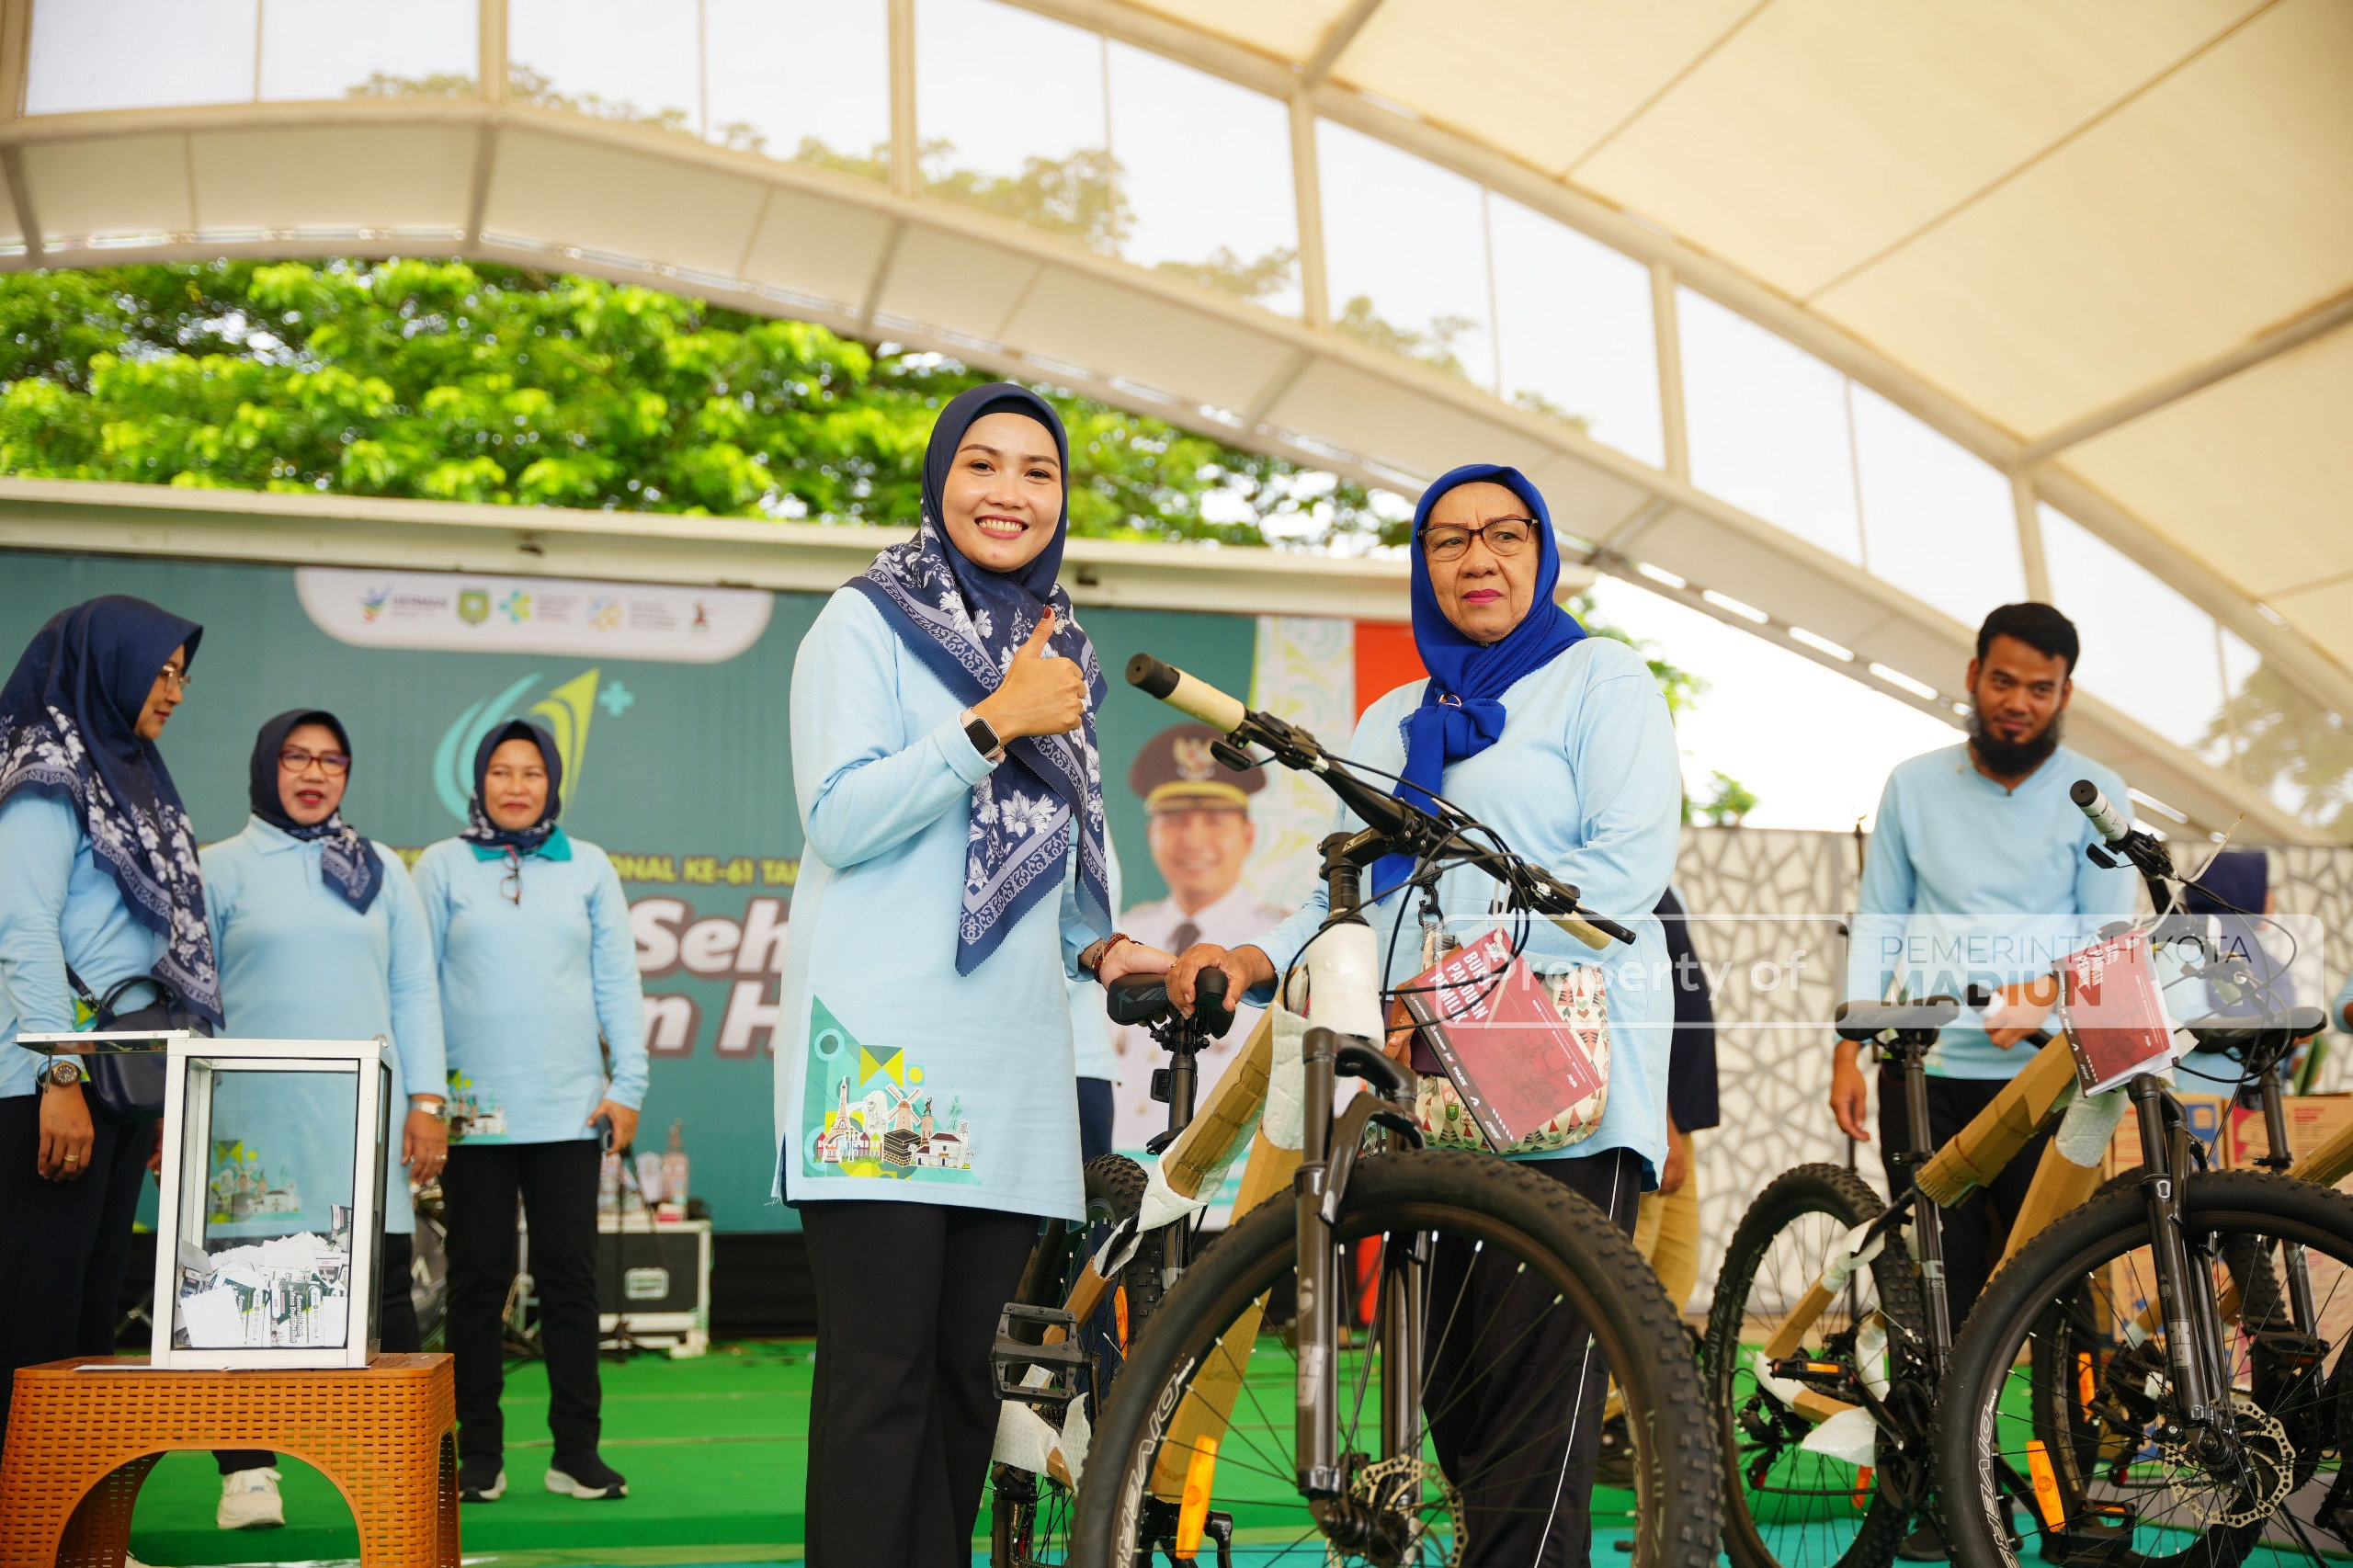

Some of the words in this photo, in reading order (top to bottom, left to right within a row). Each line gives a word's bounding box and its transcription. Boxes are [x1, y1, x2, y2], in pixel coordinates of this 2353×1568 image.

[684, 857, 755, 885] KE-61
[629, 898, 790, 973] Seh
[1452, 1066, 1469, 1087] POLICE
[1117, 1372, 1181, 1568] DIVER
